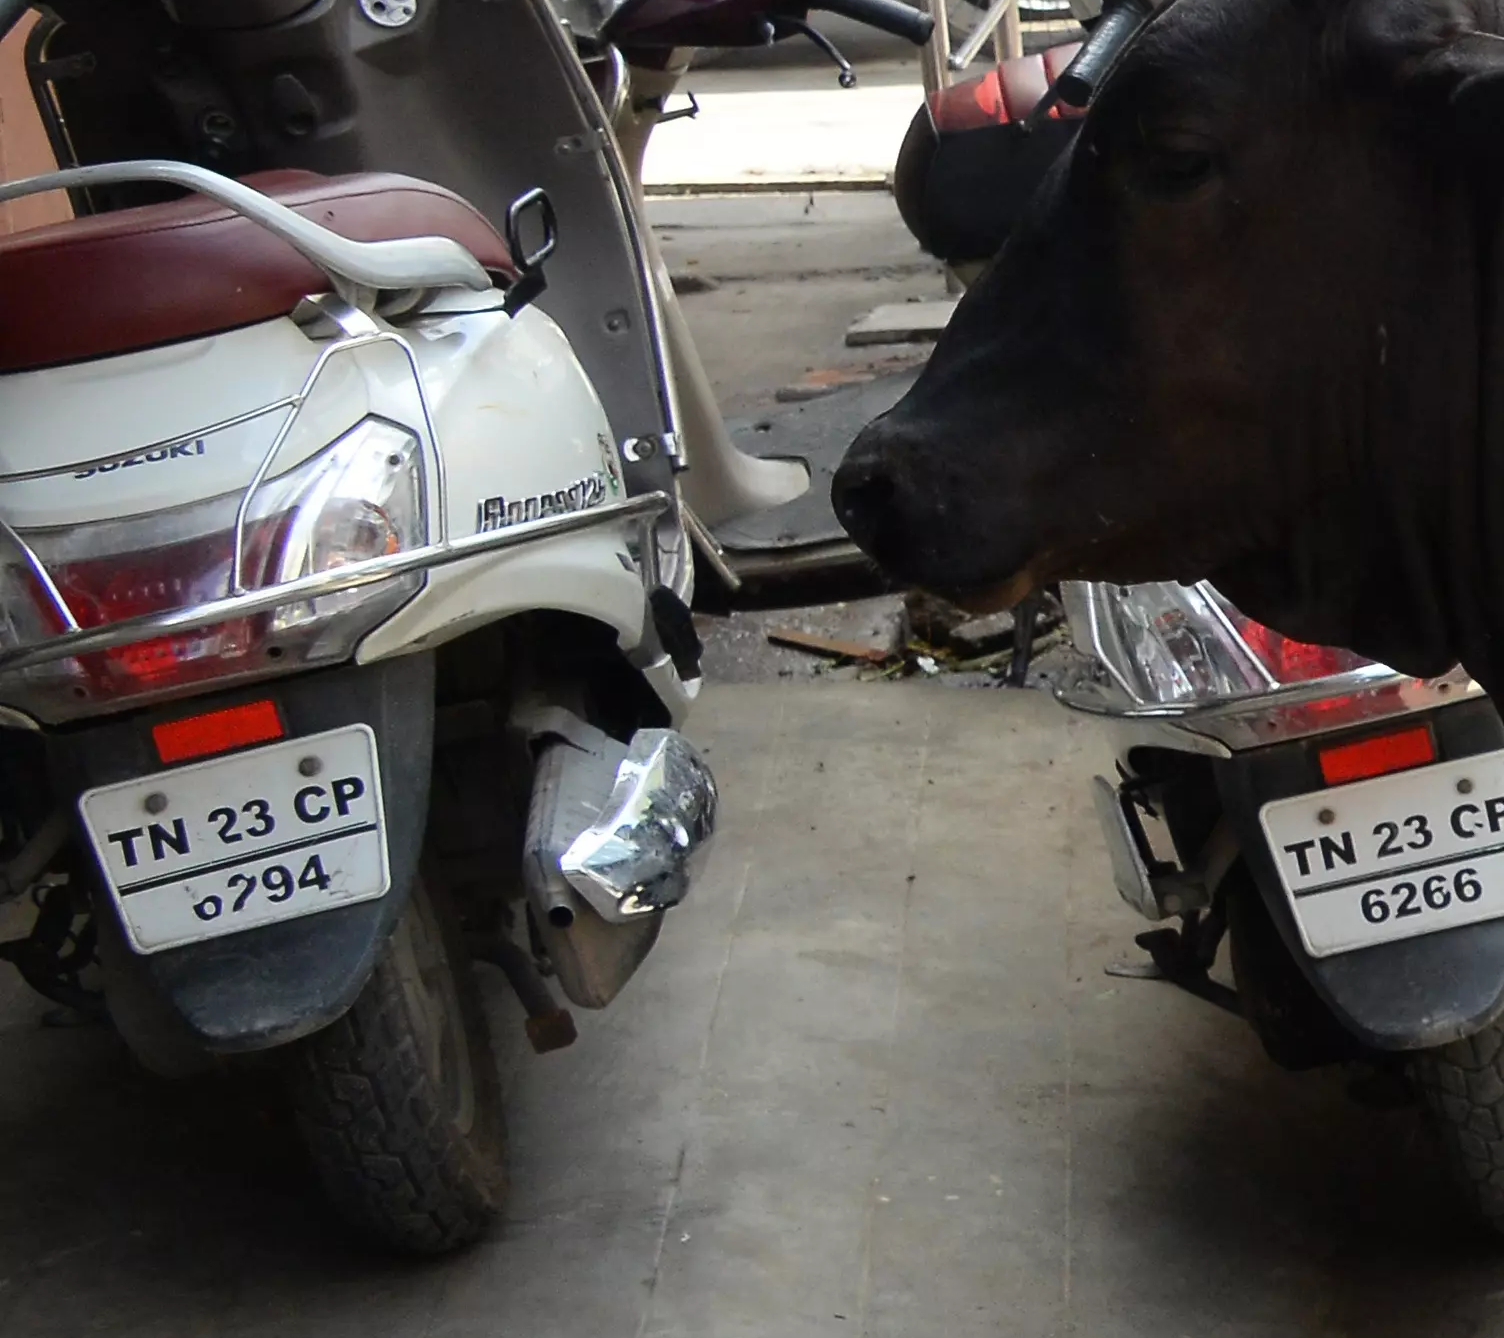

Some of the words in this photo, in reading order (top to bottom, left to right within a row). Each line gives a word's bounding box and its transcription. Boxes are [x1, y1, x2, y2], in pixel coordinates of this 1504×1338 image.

[107, 818, 191, 868] TN
[207, 798, 277, 845] 23
[293, 776, 366, 825] CP
[1283, 831, 1358, 877] TN
[1372, 814, 1434, 859] 23
[1360, 868, 1483, 924] 6266
